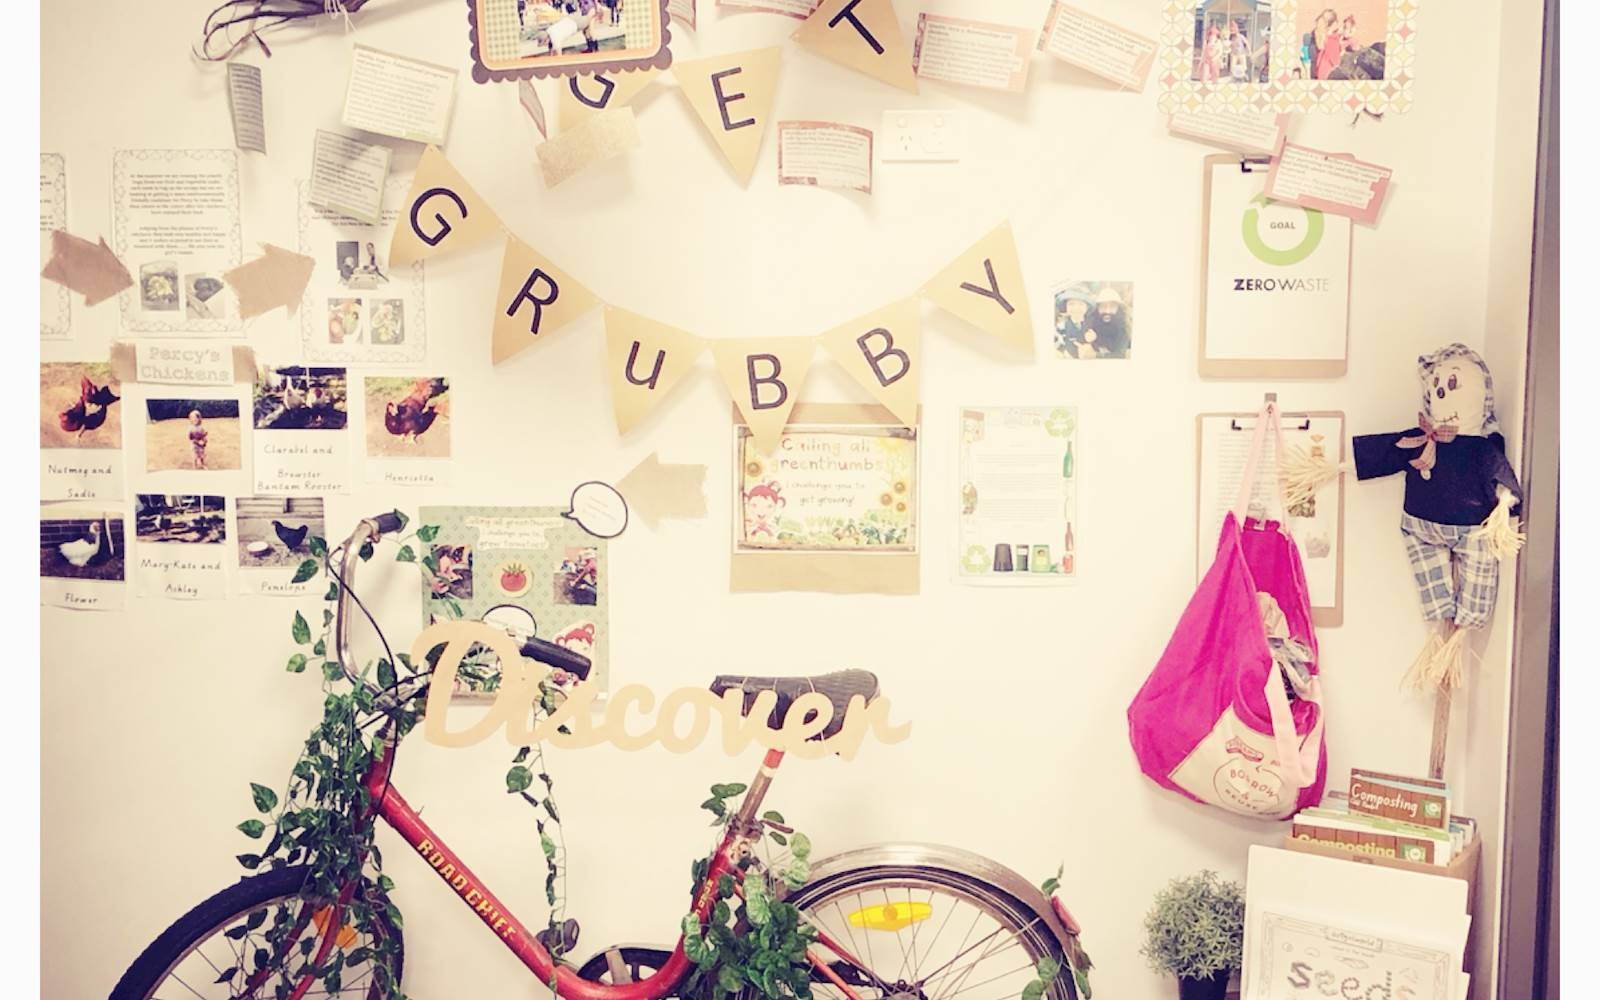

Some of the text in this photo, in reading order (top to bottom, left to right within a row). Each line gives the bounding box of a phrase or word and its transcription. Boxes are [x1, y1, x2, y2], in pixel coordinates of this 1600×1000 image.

[1269, 221, 1297, 230] GOAL
[1233, 278, 1329, 291] ZERO WASTE
[149, 346, 220, 364] Percy's
[140, 366, 231, 381] Chickens
[312, 444, 333, 454] and
[48, 465, 112, 477] Nutmeg and
[384, 472, 435, 483] Henrietta
[67, 488, 96, 498] Sadie
[201, 561, 221, 570] and
[165, 583, 198, 597] Ashley
[261, 581, 306, 592] Penelope
[65, 592, 98, 605] Flower
[410, 620, 913, 762] Discover
[1351, 783, 1418, 818] Composting
[417, 838, 468, 891] ROAD
[465, 888, 517, 938] CHIEF
